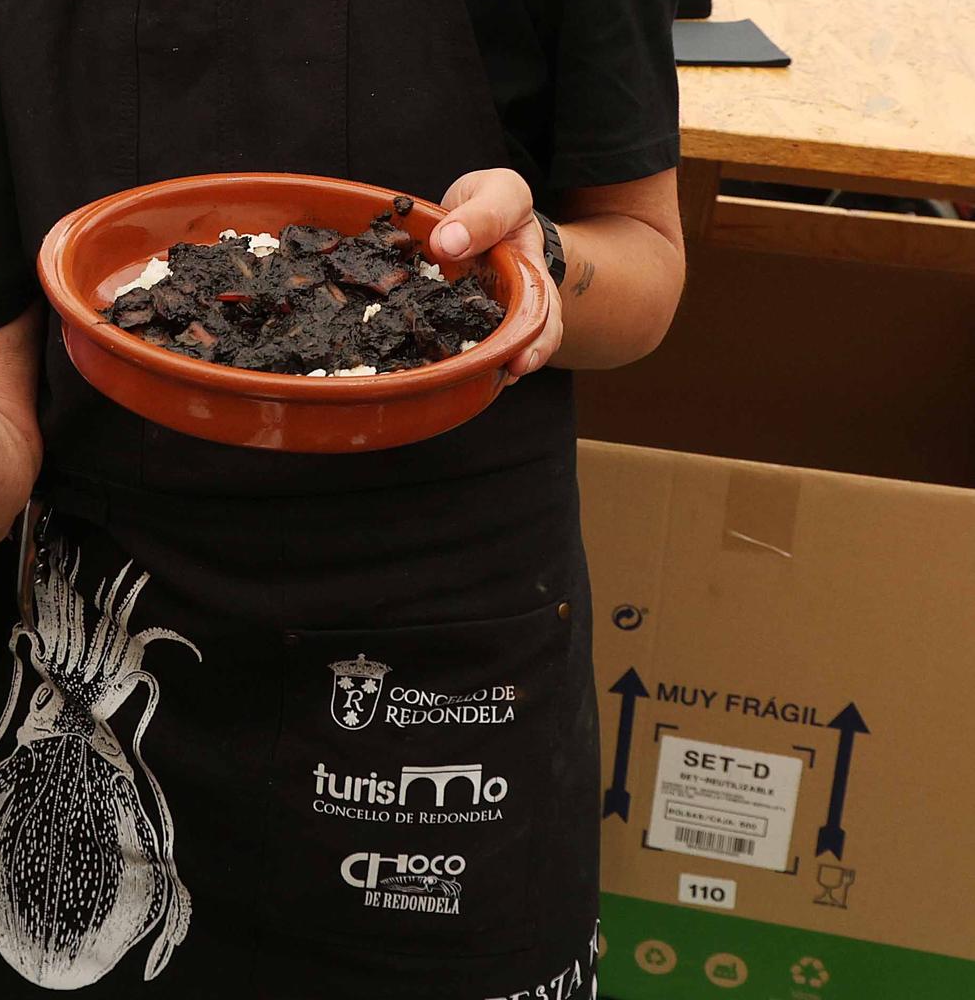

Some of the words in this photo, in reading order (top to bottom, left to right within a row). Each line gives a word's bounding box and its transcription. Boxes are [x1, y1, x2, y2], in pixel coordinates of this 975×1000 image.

[389, 686, 487, 707] CONCELLO
[492, 685, 516, 702] DE
[656, 682, 718, 710] MUY
[725, 693, 824, 727] FRÁGIL
[385, 705, 515, 728] REDONDELA
[683, 750, 771, 779] SET-D
[313, 799, 390, 823] CONCELLO
[395, 811, 414, 825] DE
[419, 809, 504, 825] REDONDELA
[340, 852, 466, 888] CHOCO
[364, 891, 380, 907] DE
[383, 892, 460, 915] REDONDELA
[688, 883, 726, 902] 110
